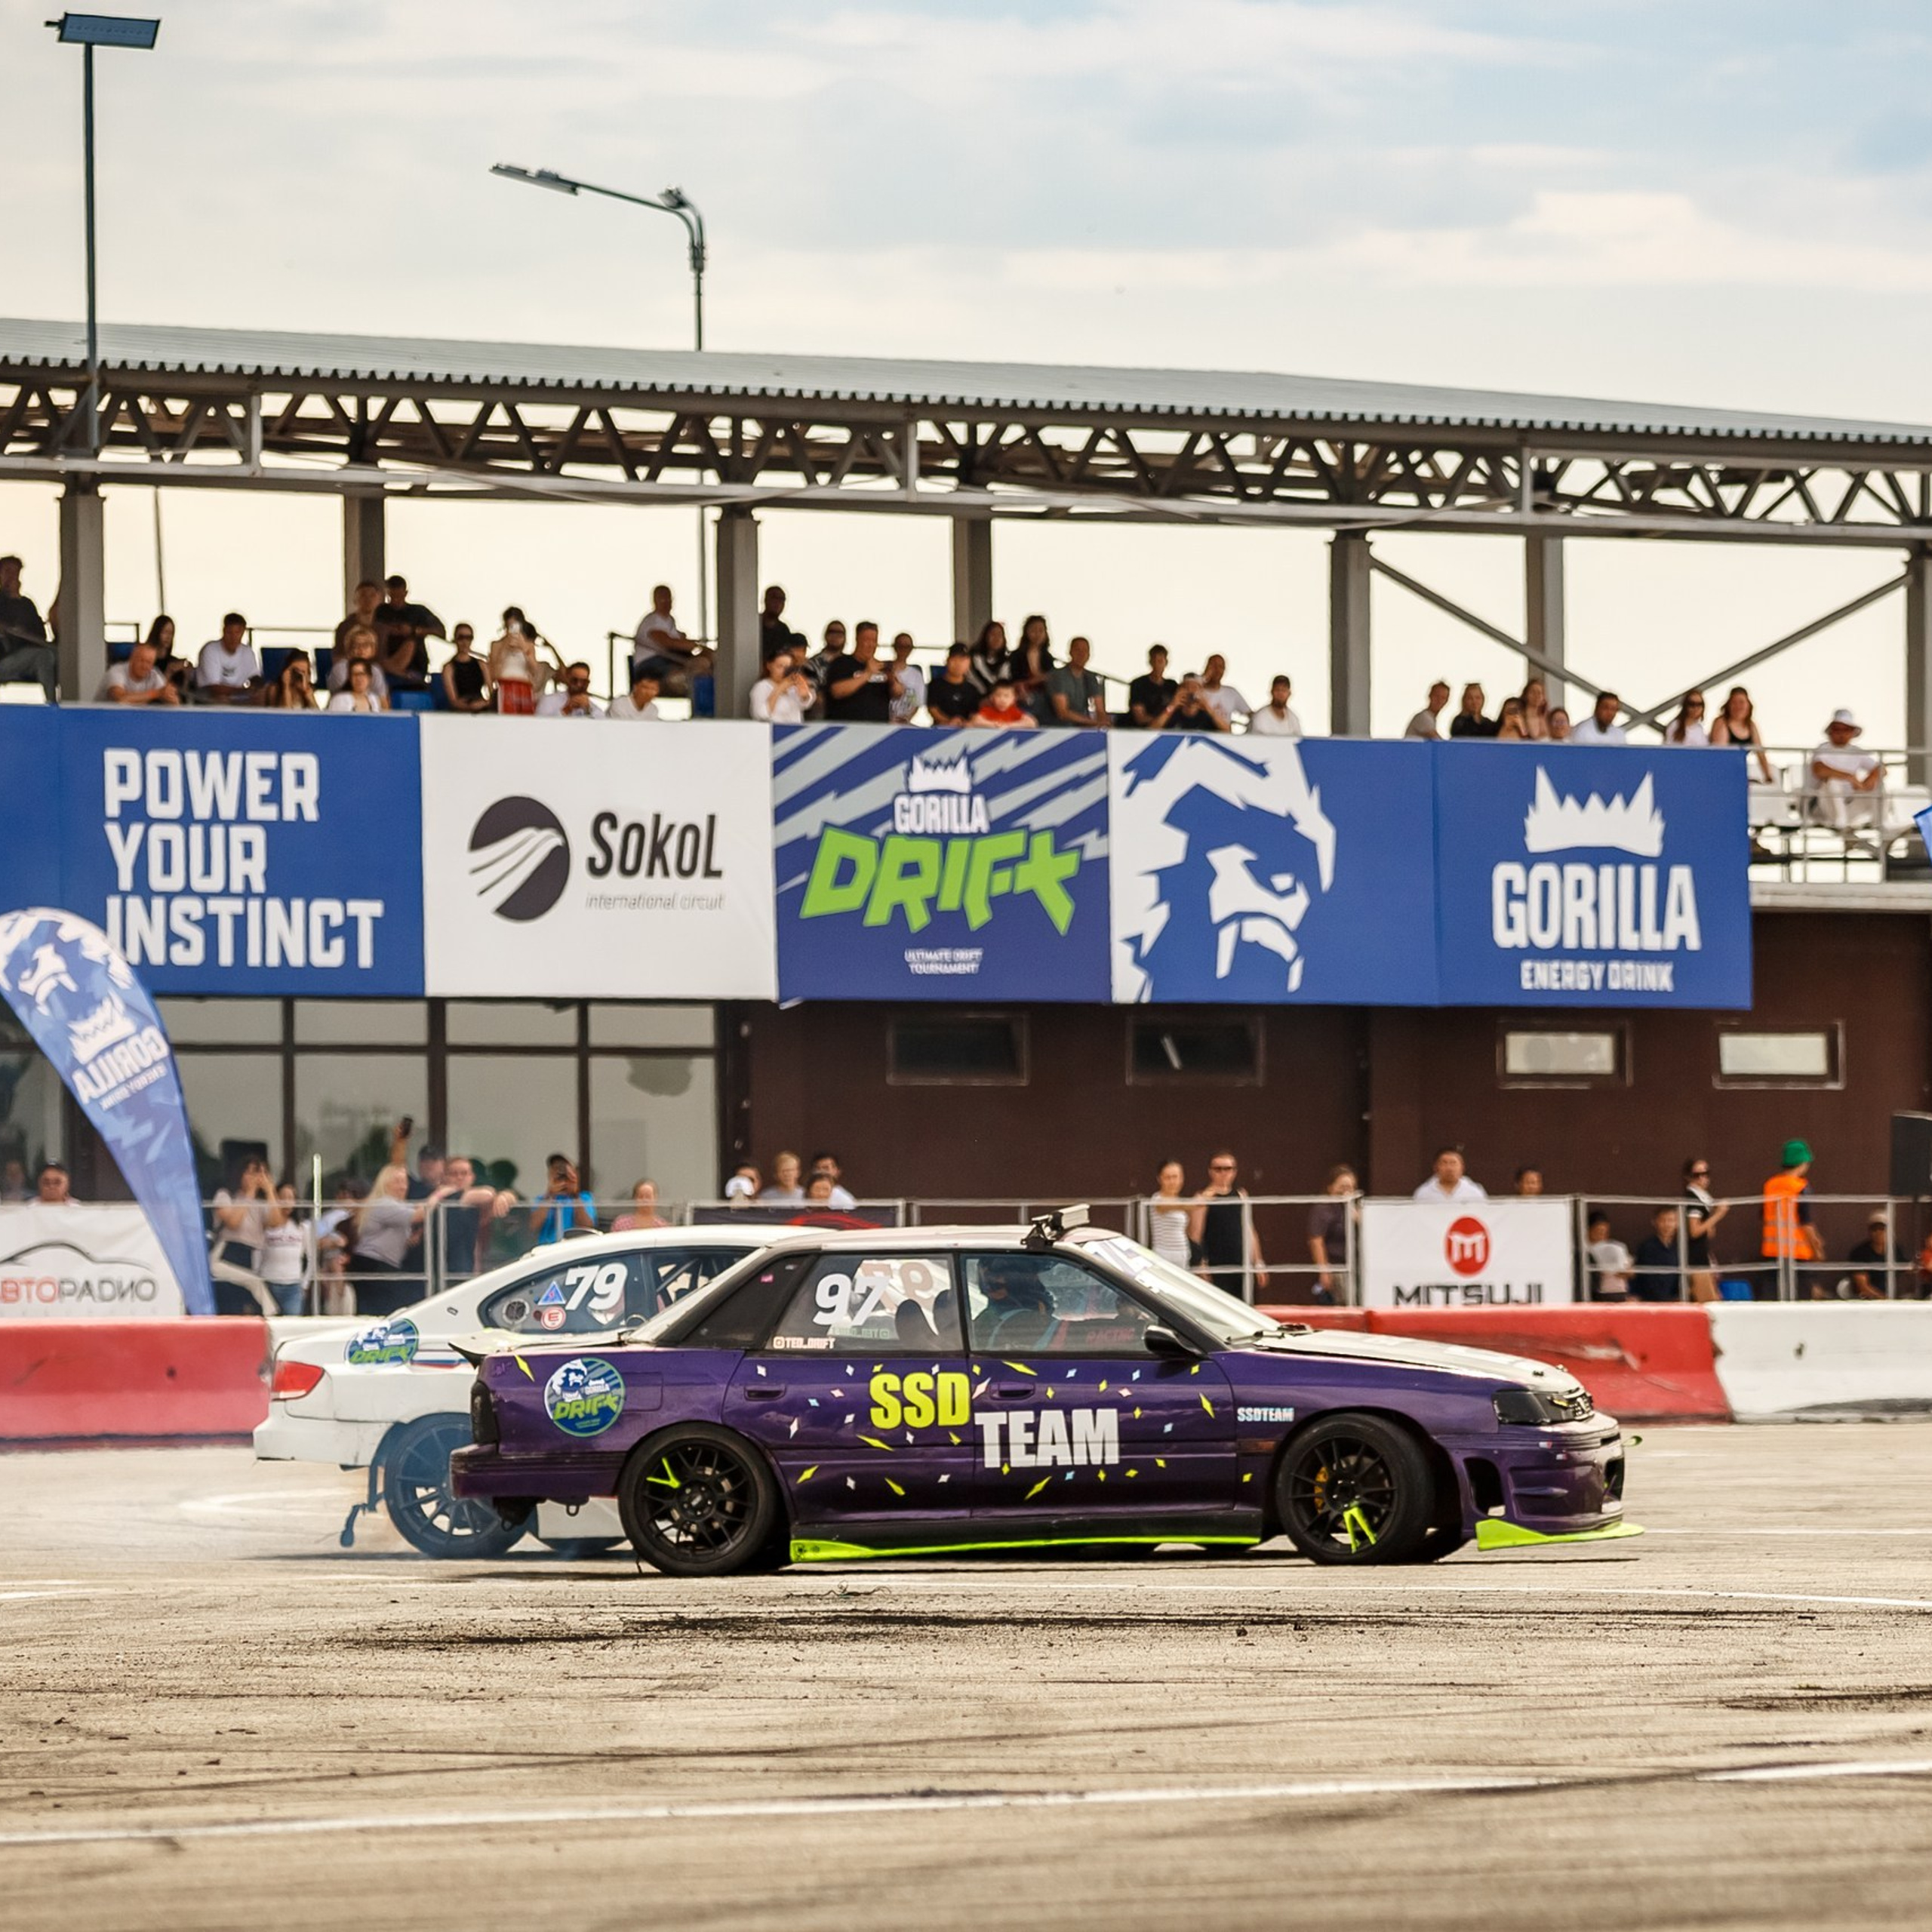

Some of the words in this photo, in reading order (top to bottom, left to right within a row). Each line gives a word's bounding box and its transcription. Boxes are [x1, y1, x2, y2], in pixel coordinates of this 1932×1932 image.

[103, 748, 319, 821] POWER
[894, 795, 989, 834] GORILLA
[104, 822, 266, 894] YOUR
[799, 827, 1081, 936] DRIFT
[586, 893, 676, 910] international
[680, 894, 724, 910] circuit
[1492, 862, 1702, 951] GORILLA
[106, 895, 384, 968] INSTINCT
[904, 948, 952, 962] ULTIMATE
[952, 948, 983, 961] DRIFT
[909, 961, 980, 974] TOURNAMENT
[1520, 959, 1604, 991] ENERGY
[1607, 961, 1674, 992] DRINK
[565, 1263, 628, 1310] 79
[813, 1273, 891, 1325] 97
[1393, 1284, 1543, 1305] MITSUJI
[552, 1394, 620, 1420] DRIFT
[869, 1372, 971, 1429] SSD
[1237, 1407, 1294, 1422] SSDTEAM
[974, 1408, 1120, 1468] TEAM
